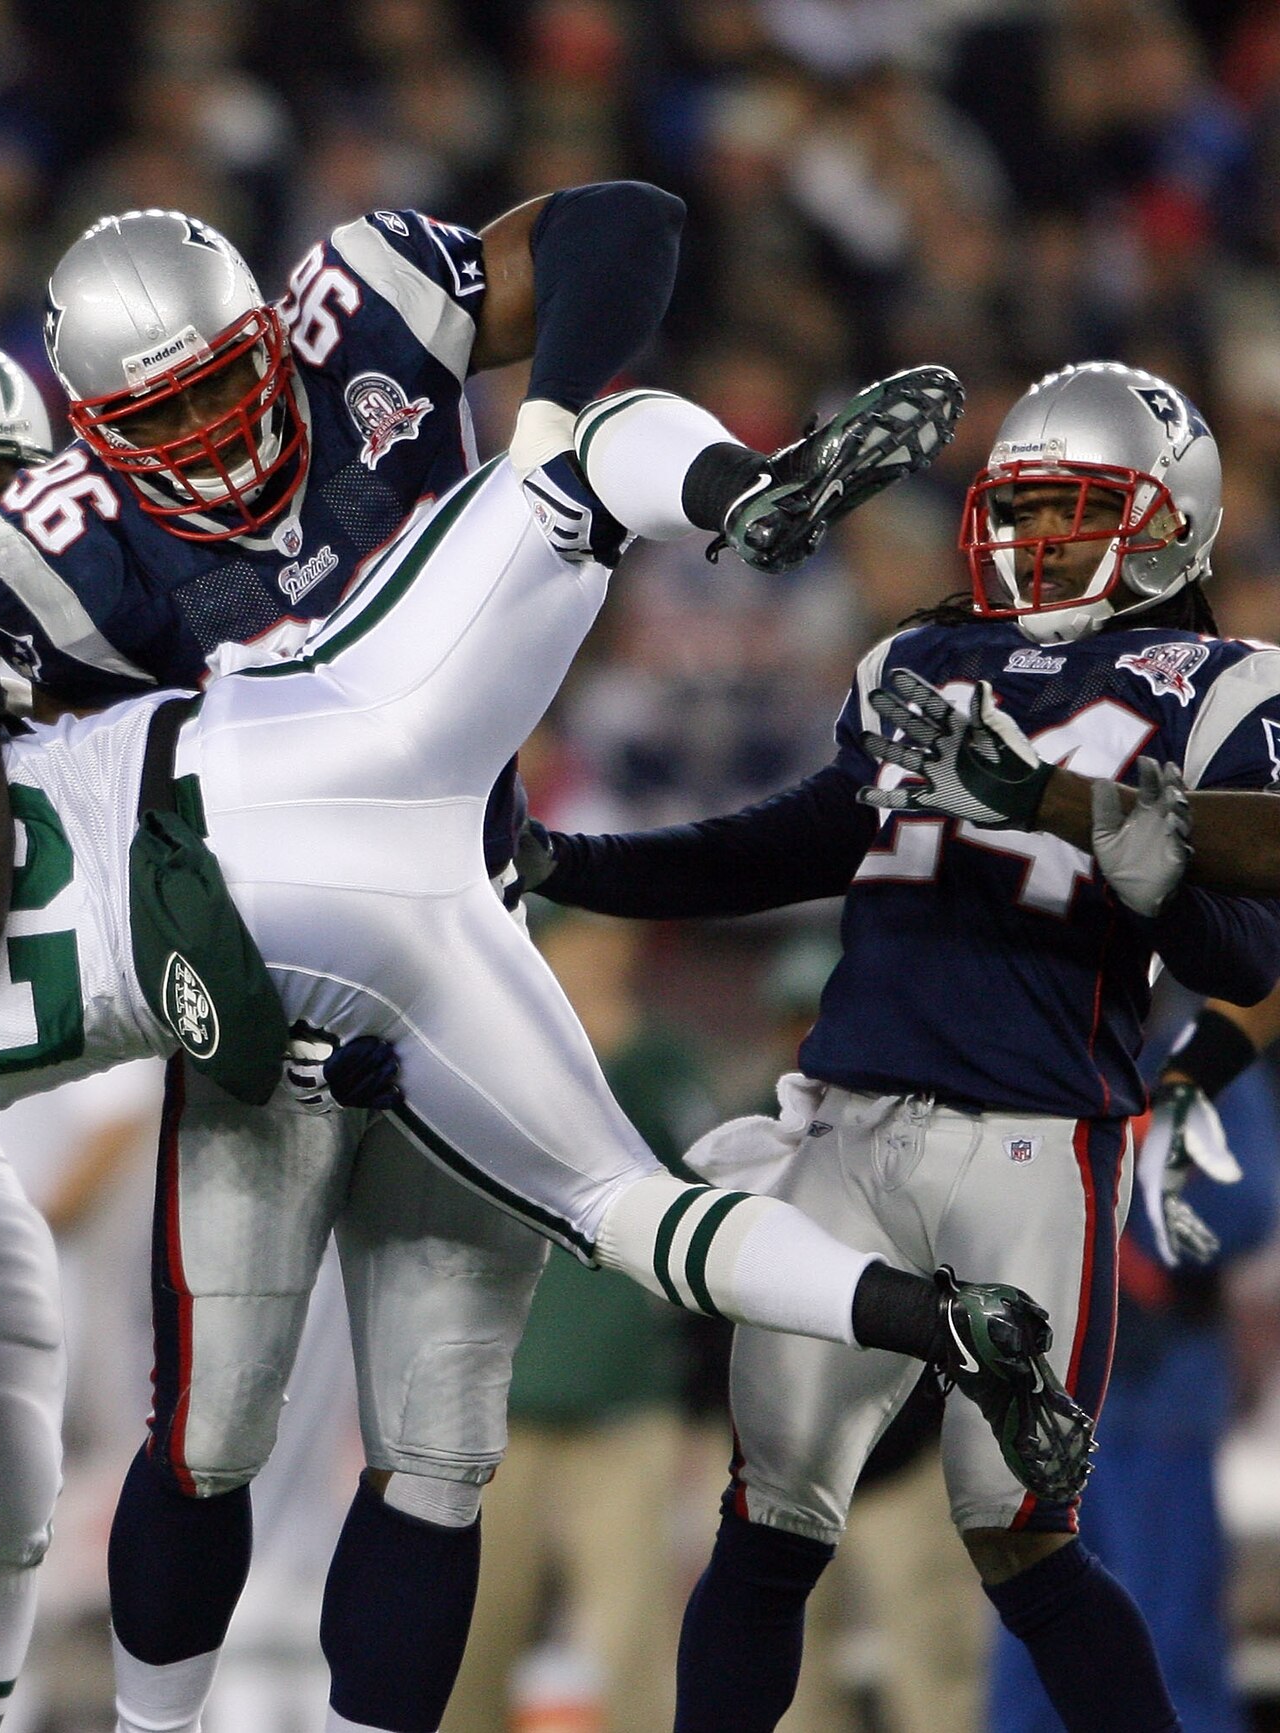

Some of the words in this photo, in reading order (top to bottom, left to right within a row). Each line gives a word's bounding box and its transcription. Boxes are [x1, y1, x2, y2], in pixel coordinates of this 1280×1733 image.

[277, 240, 364, 367] 96
[142, 340, 185, 368] Riddell
[1, 449, 120, 556] 96
[284, 545, 339, 605] Patriots
